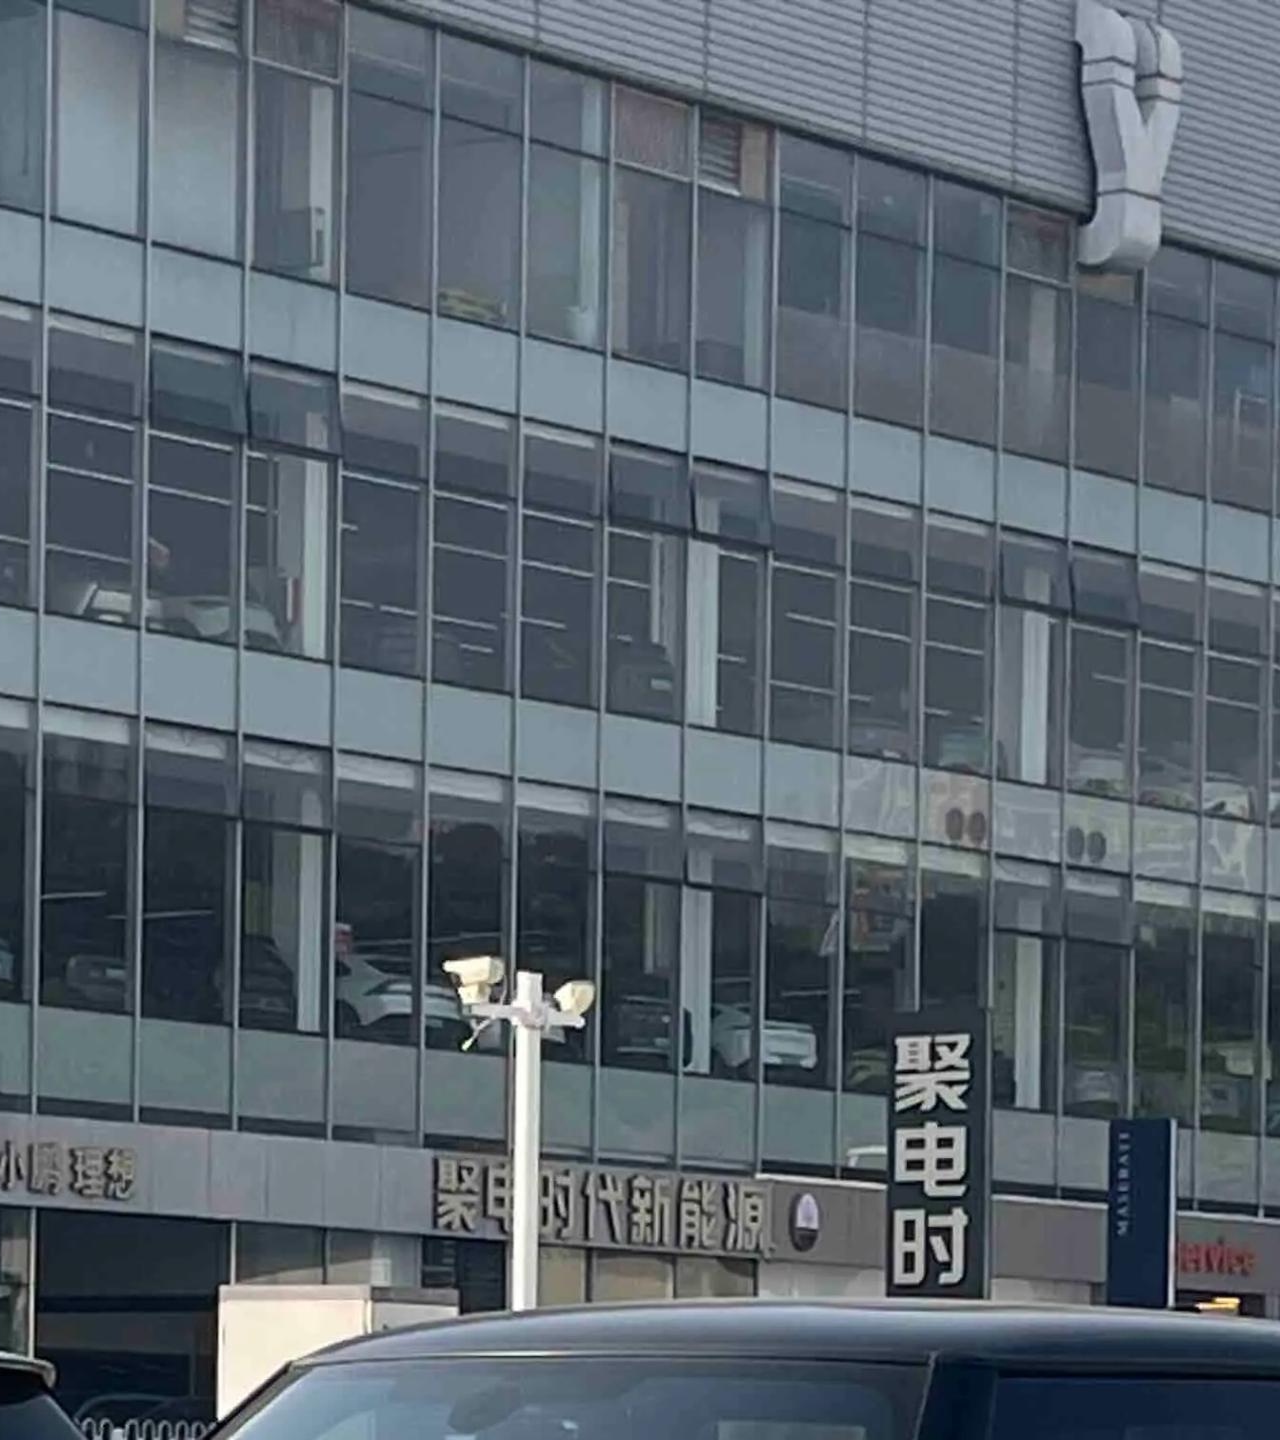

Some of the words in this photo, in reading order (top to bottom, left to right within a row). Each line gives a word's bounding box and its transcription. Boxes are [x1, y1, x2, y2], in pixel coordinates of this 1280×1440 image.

[893, 1033, 971, 1287] 聚电时
[1116, 1131, 1131, 1236] MASERATI
